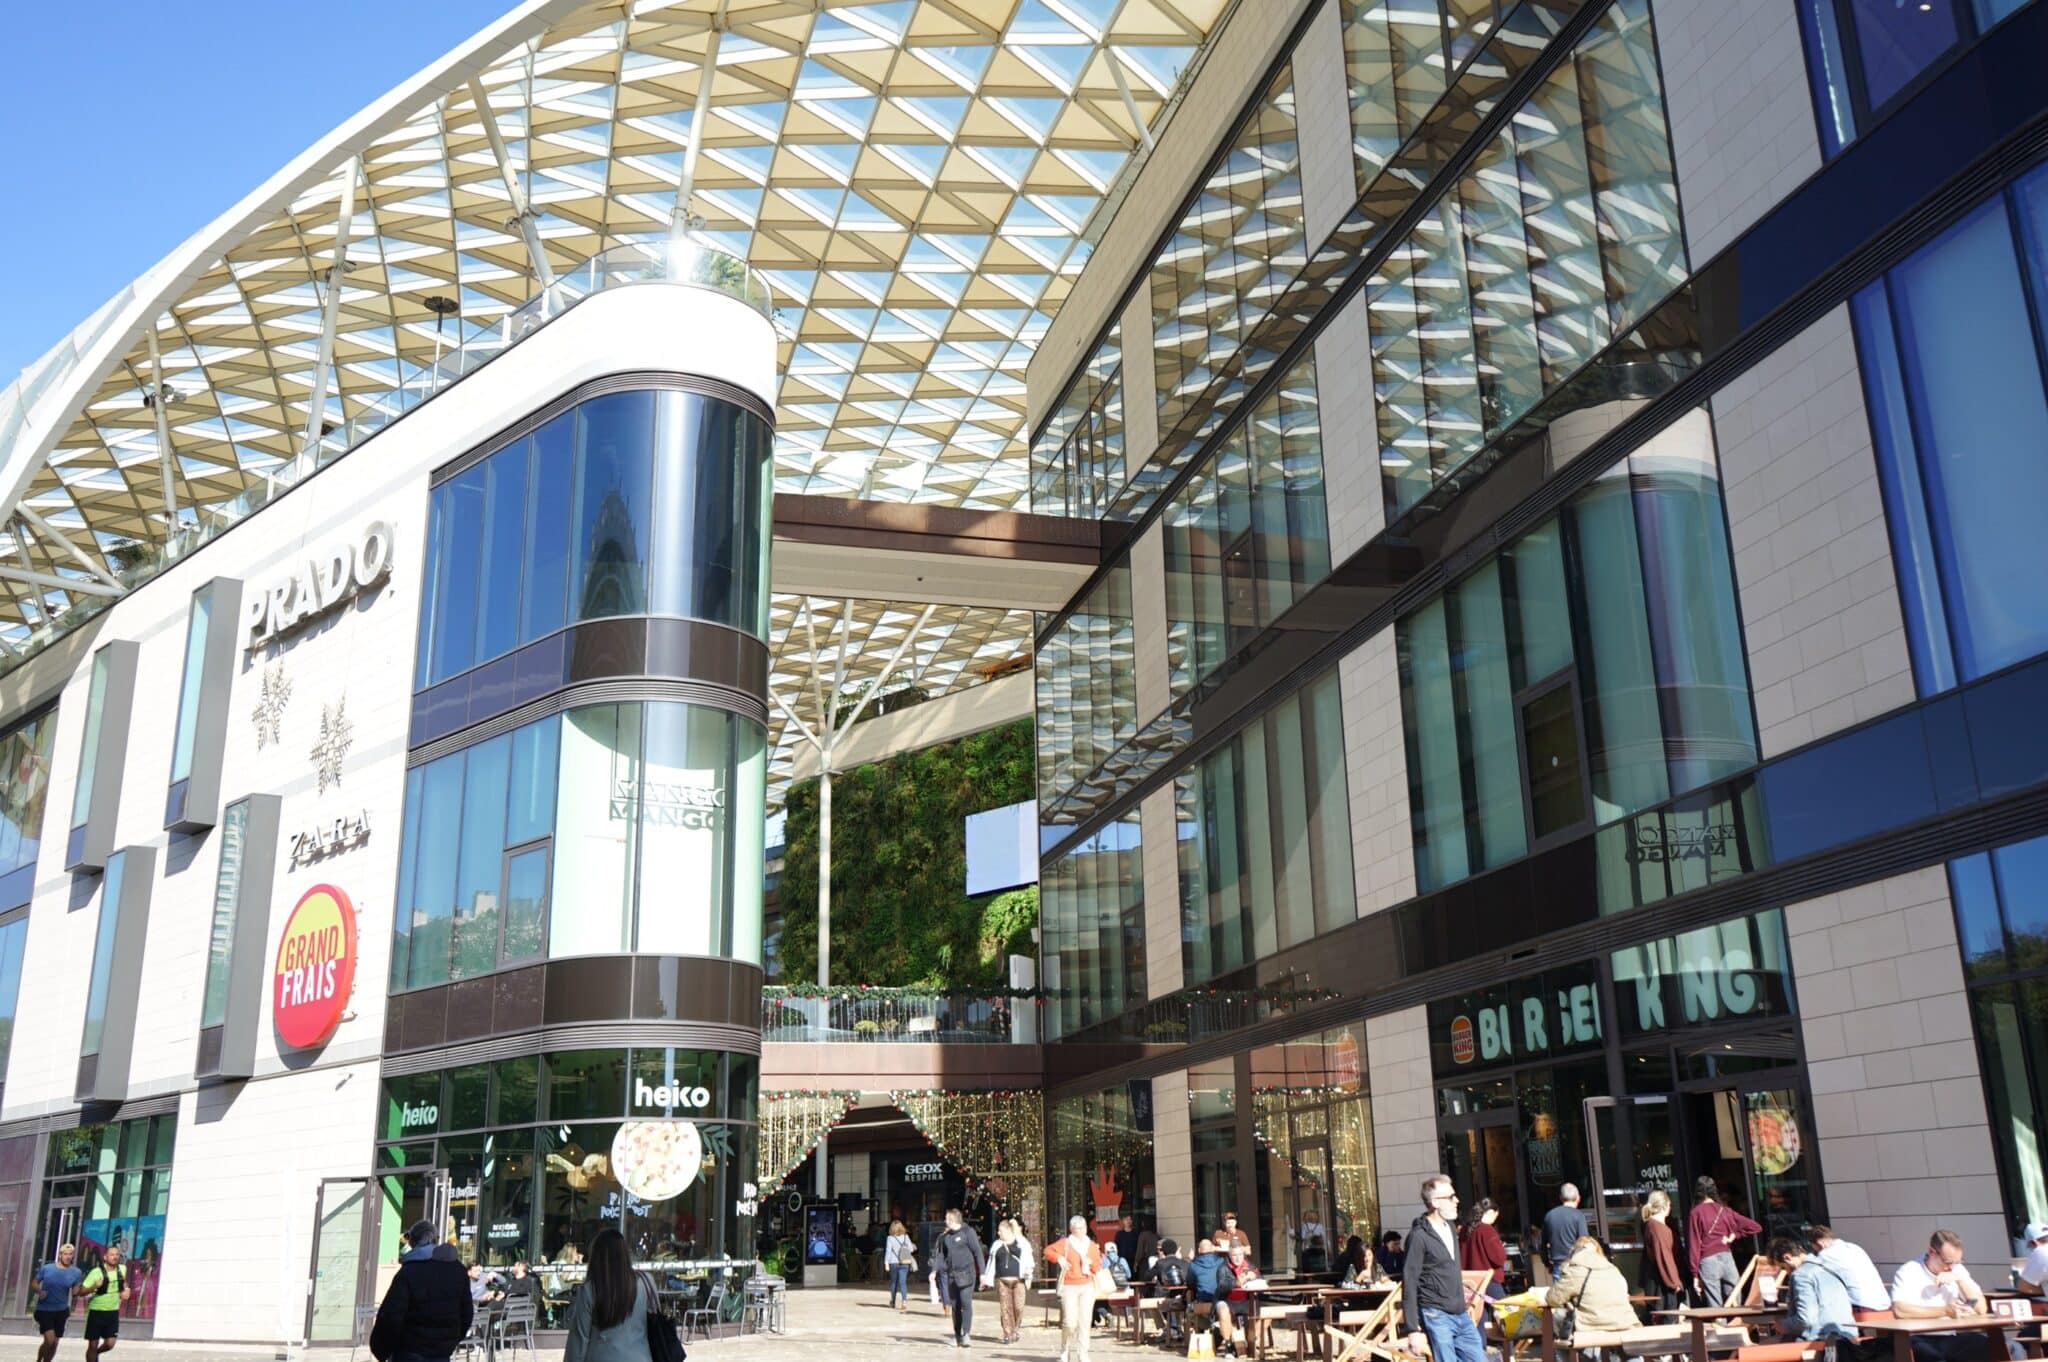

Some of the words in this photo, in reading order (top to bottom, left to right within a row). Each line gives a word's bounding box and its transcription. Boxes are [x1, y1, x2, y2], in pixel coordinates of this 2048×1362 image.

[242, 520, 395, 651] PRADO
[289, 807, 371, 859] ZARA
[285, 924, 340, 971] GRAND
[280, 958, 337, 1009] FRAIS
[1635, 948, 1756, 1031] KNG
[1454, 1039, 1474, 1054] KING
[401, 1100, 438, 1127] heiko
[634, 1077, 710, 1108] heiko
[905, 1163, 943, 1175] GEOX
